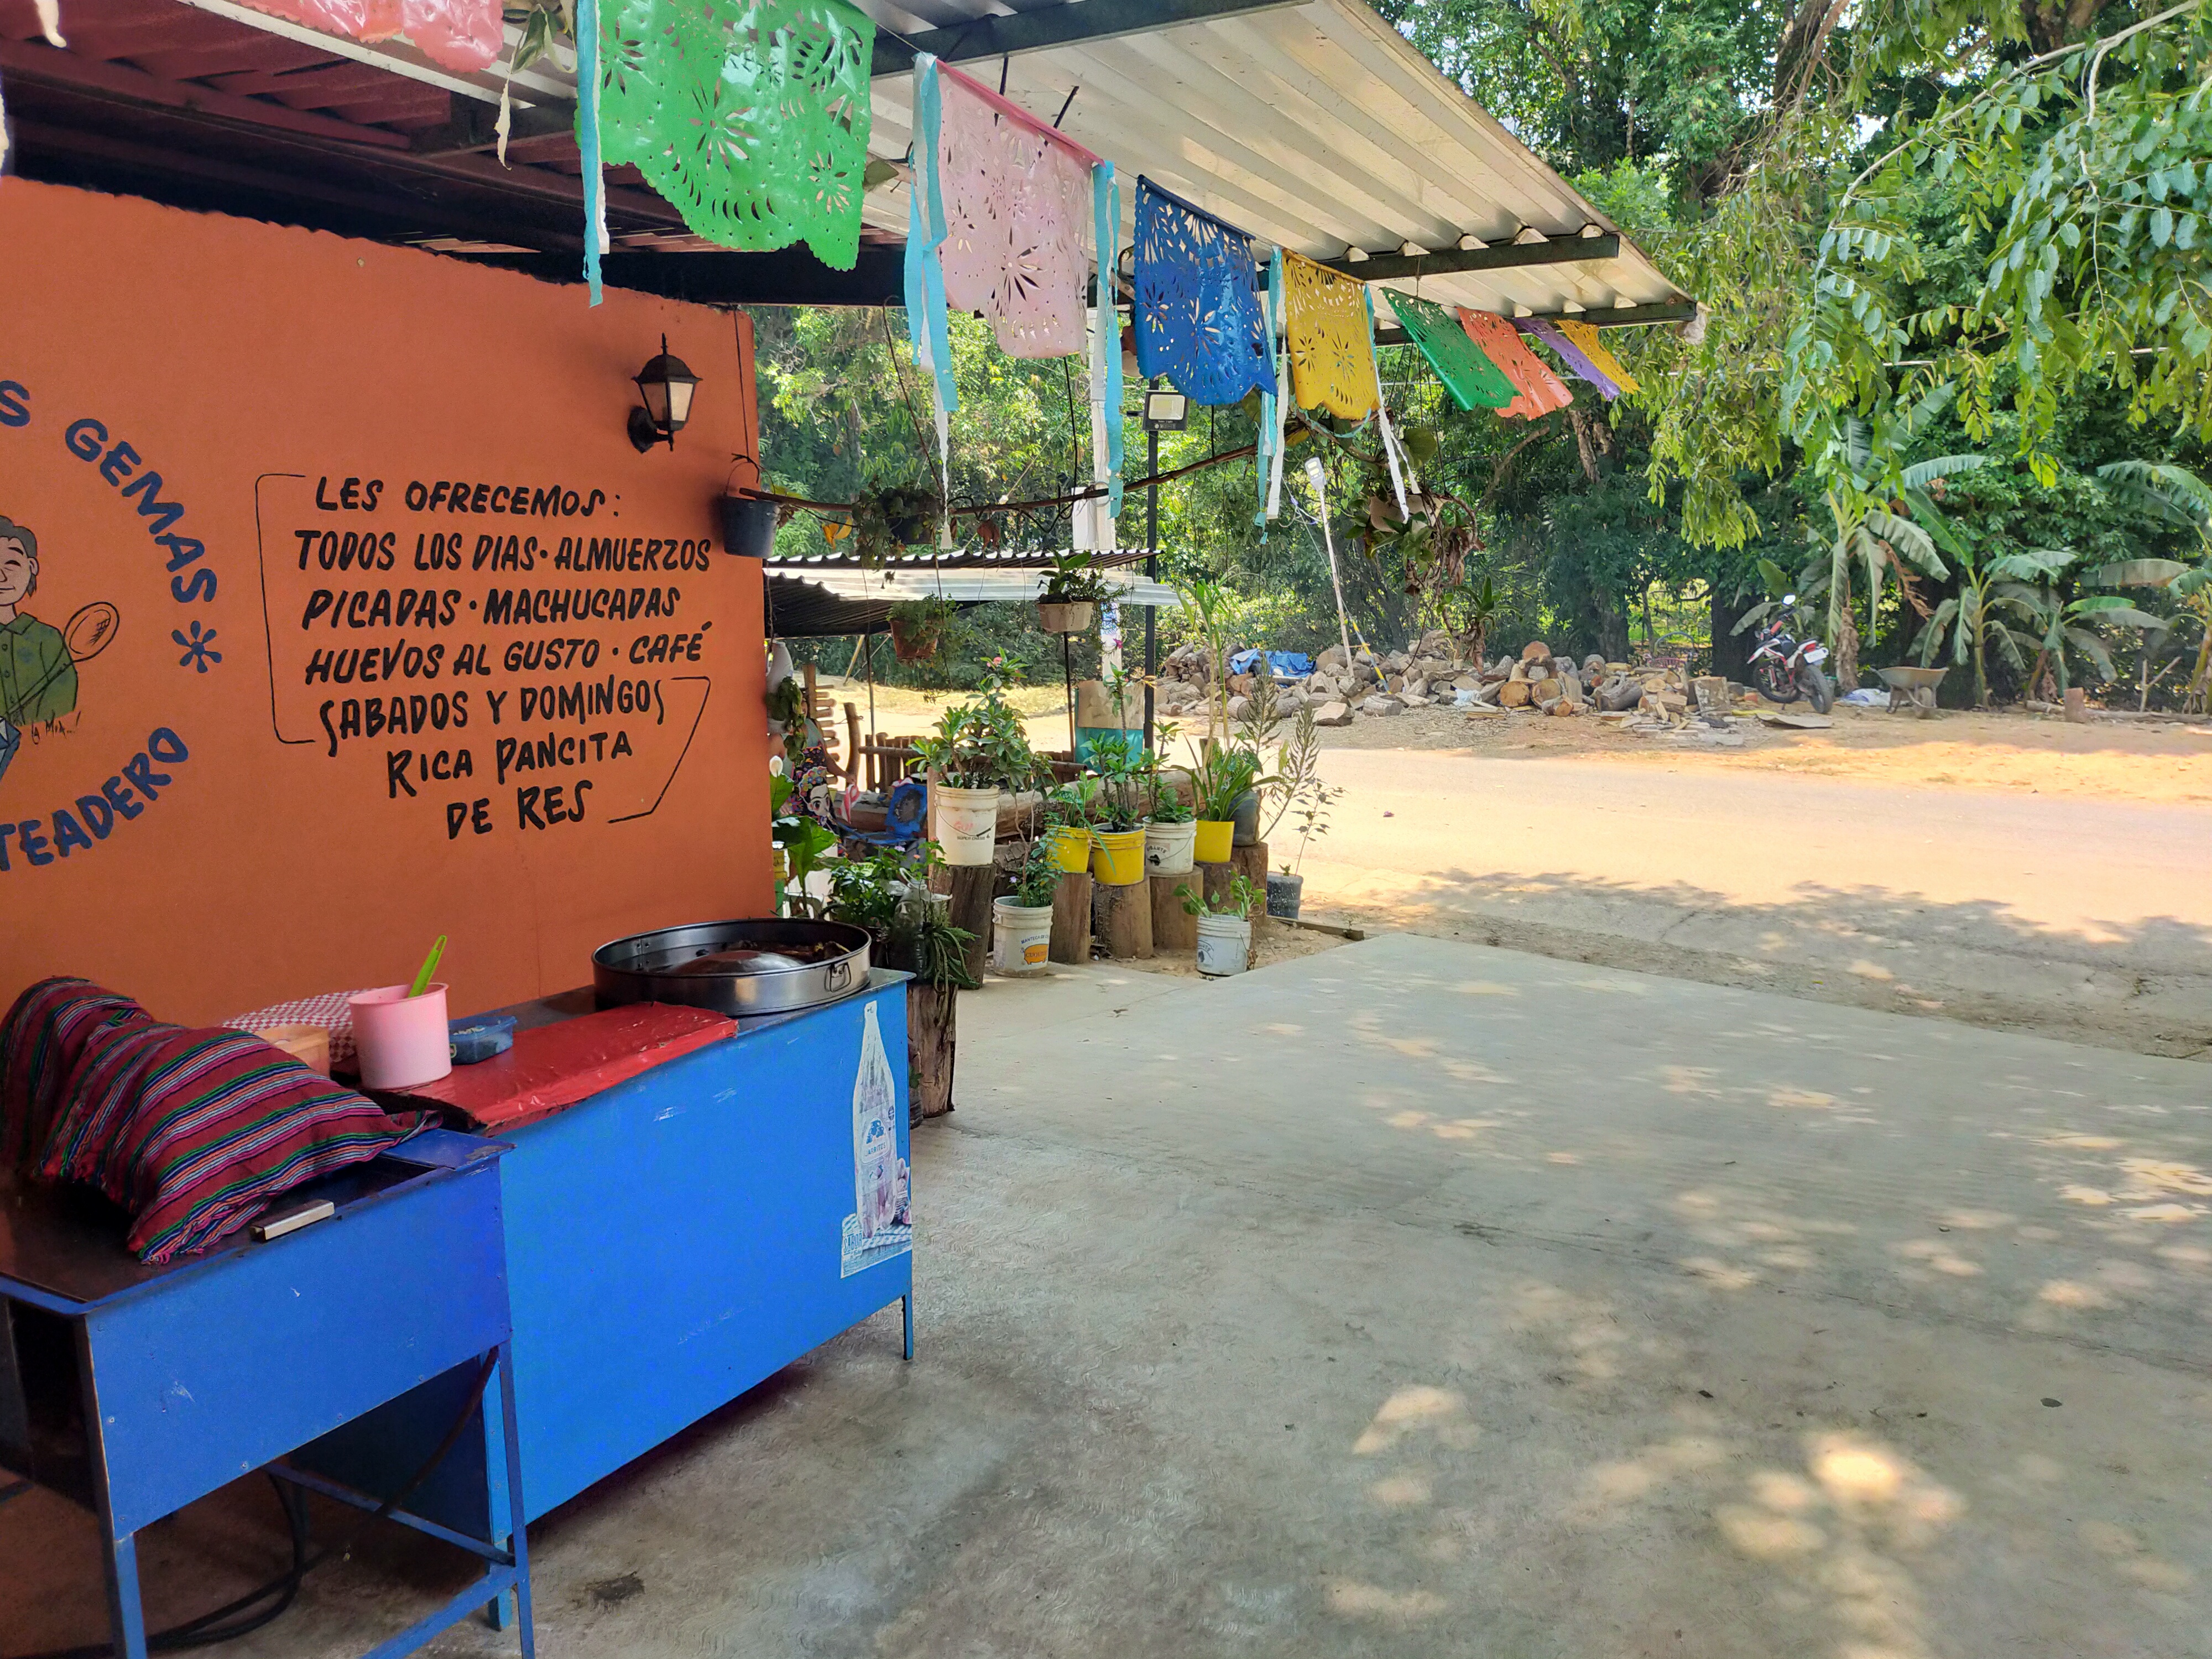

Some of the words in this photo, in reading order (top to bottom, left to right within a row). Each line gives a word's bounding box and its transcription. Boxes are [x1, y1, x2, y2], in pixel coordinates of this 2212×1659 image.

[0, 380, 30, 426] S
[65, 419, 217, 603] GEMAS
[316, 477, 383, 512] LES
[295, 530, 395, 571] TODOS
[415, 533, 462, 571] LOS
[554, 538, 711, 571] ALMUERZOS
[302, 589, 461, 630] PICADAS
[483, 587, 680, 625] MACHUCADAS
[305, 639, 445, 685] HUEVOS
[453, 644, 491, 676] AL
[504, 638, 599, 671] GUSTO
[629, 622, 712, 664] CAFÉ
[320, 691, 468, 757] SABADOS
[487, 690, 508, 724] Y
[521, 675, 664, 725] DOMINGOS
[387, 750, 472, 799] RICA
[497, 731, 632, 785] PANCITA
[0, 727, 189, 872] TEADERO
[447, 798, 492, 839] DE
[518, 780, 592, 830] RES
[843, 1232, 862, 1254] SABOR
